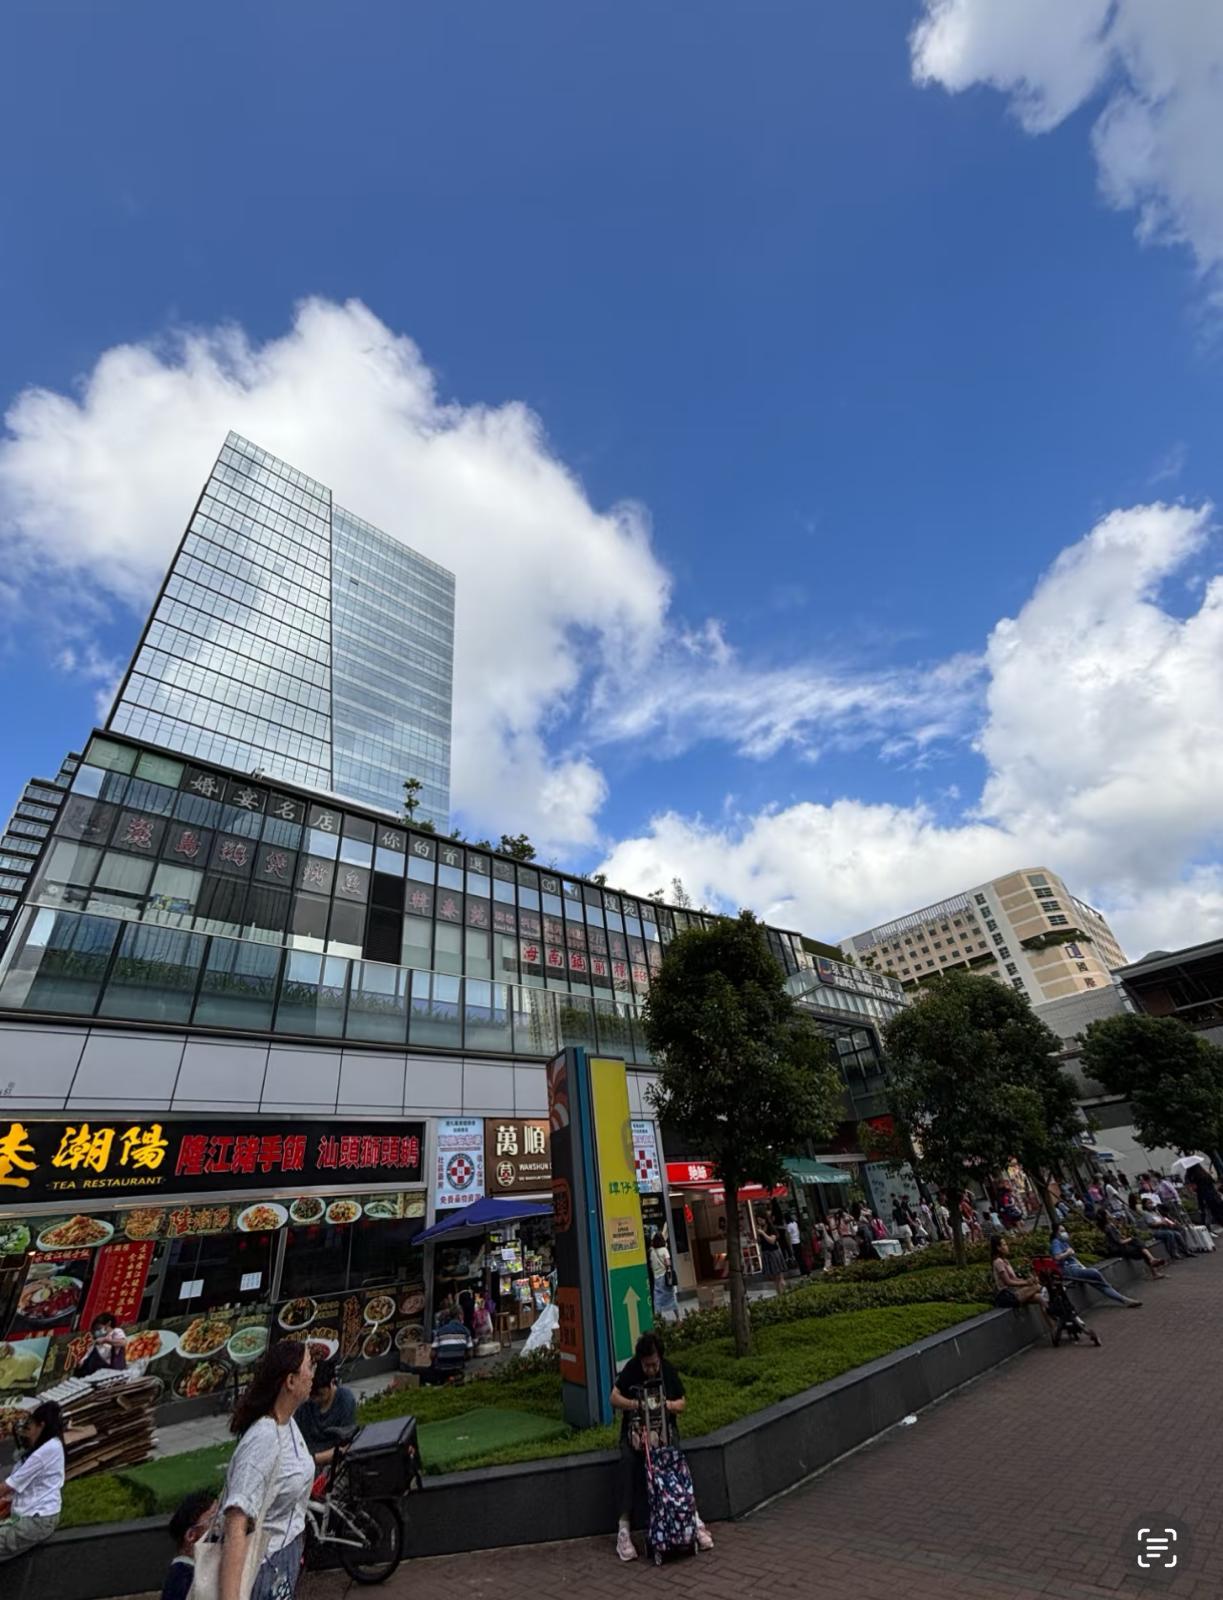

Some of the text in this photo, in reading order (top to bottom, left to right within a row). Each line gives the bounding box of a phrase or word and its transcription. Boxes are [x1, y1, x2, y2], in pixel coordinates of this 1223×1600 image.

[496, 1125, 546, 1156] 萬順
[52, 1176, 163, 1190] TEA RESTAURANT
